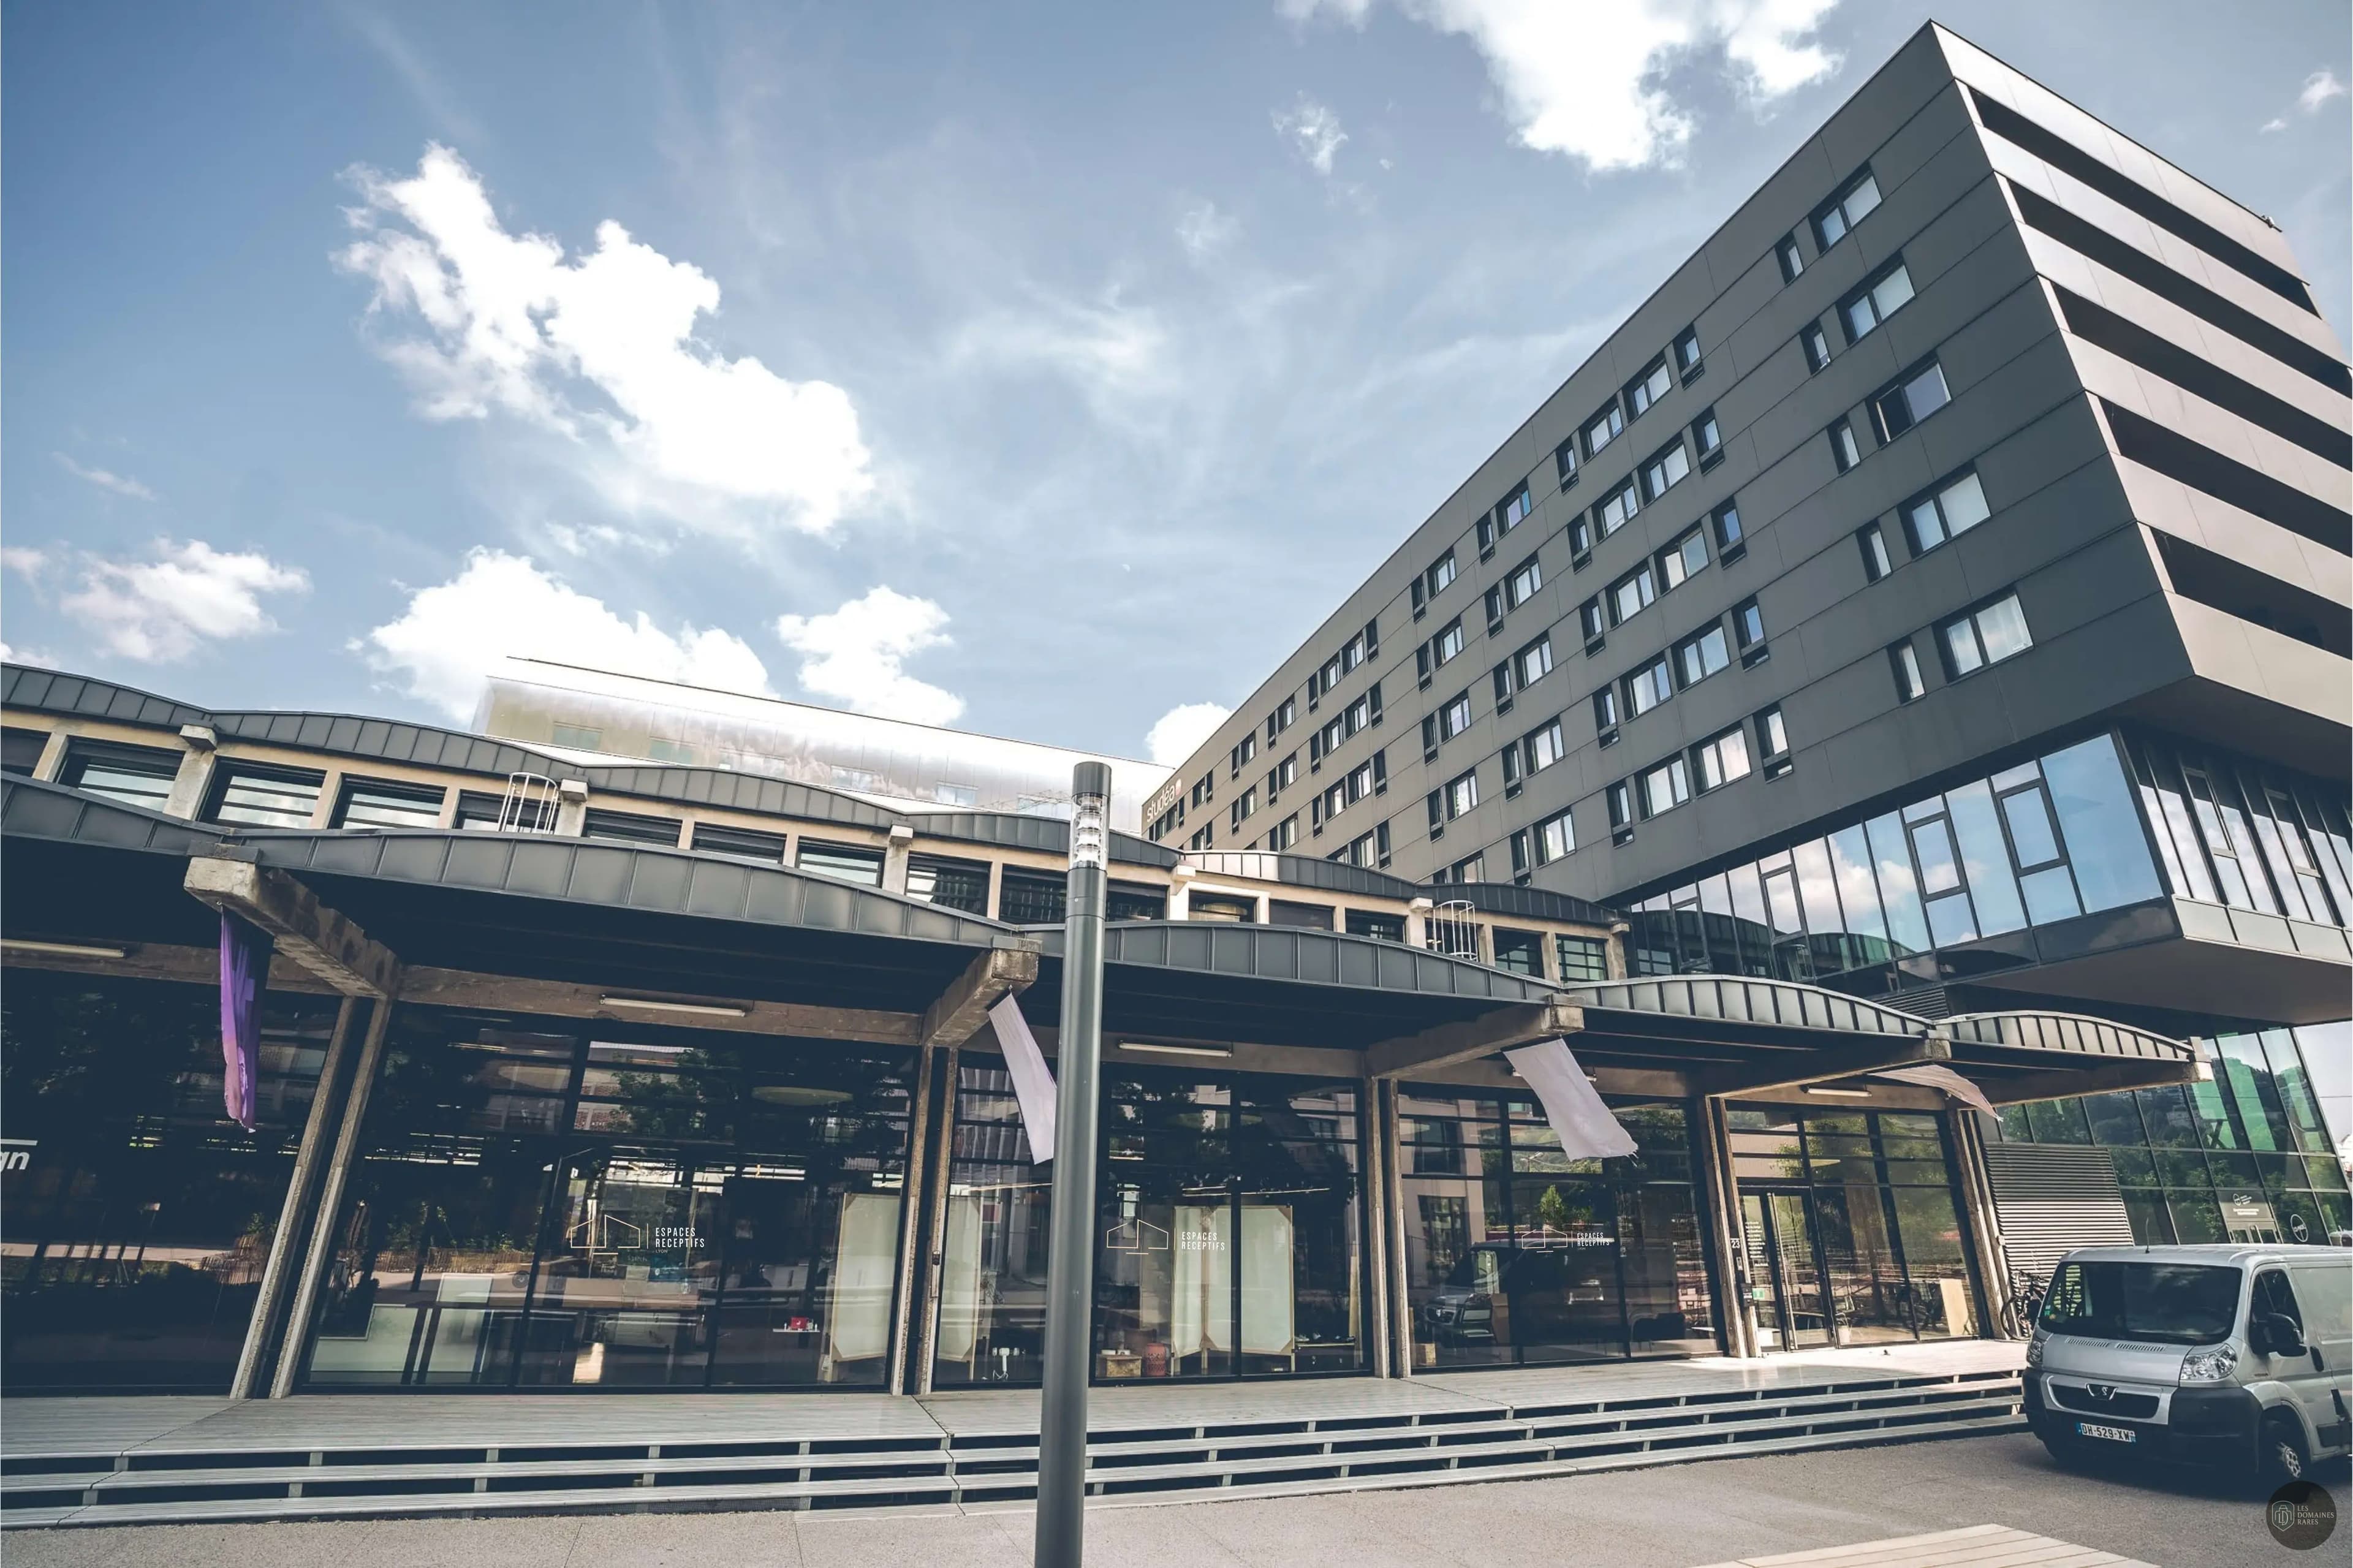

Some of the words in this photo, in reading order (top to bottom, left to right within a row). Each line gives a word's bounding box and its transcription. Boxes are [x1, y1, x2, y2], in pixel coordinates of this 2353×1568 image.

[1146, 785, 1175, 823] studéa
[655, 1227, 696, 1237] ESPACES
[1181, 1231, 1218, 1241] ESPACES
[655, 1238, 705, 1248] RECEPTIFS
[1181, 1241, 1226, 1251] RECEPTIFS
[1731, 1240, 1740, 1249] 23
